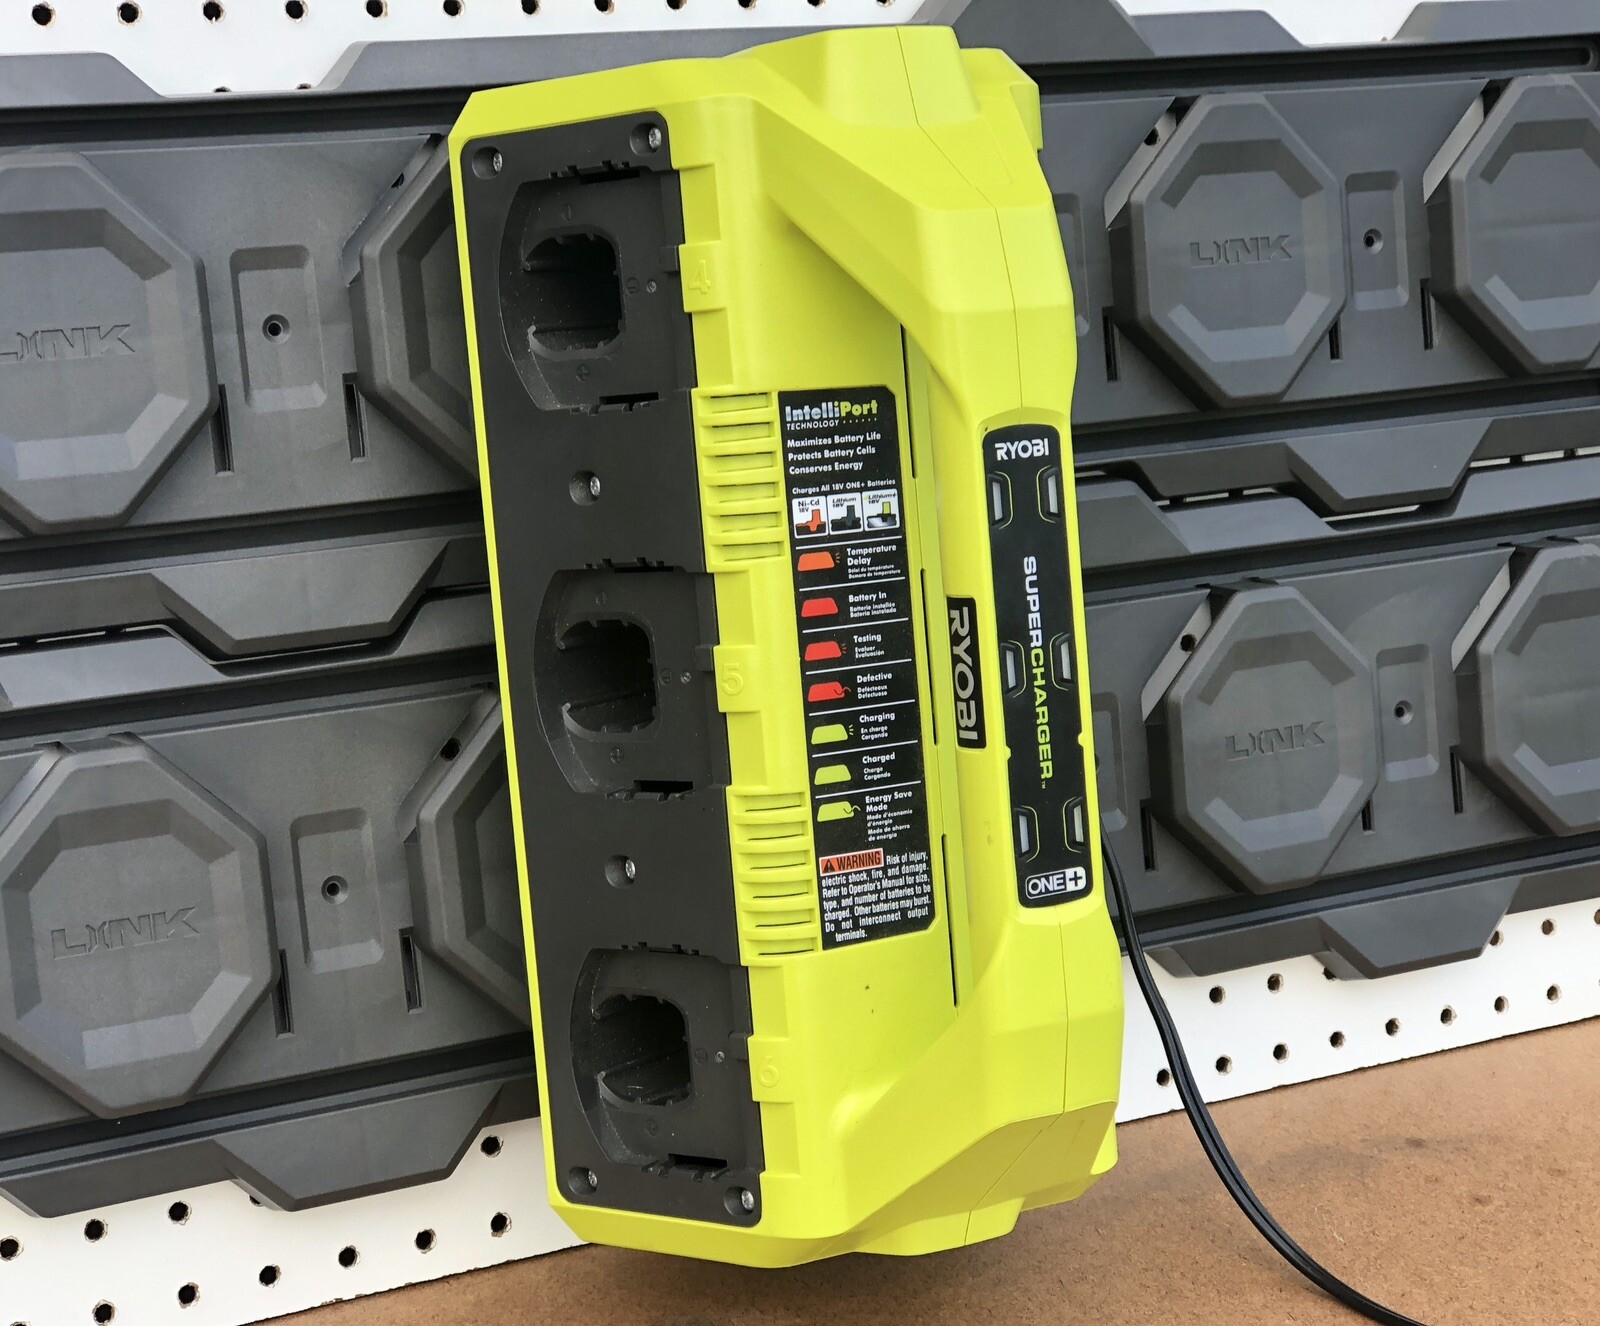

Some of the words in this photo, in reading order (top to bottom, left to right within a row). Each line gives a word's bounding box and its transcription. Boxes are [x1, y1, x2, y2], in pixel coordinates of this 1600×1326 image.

[687, 259, 711, 294] 4
[785, 400, 878, 421] IntelliPort
[786, 420, 839, 431] TECHNOLOGY
[787, 437, 832, 448] Maximizes
[834, 434, 864, 444] Battery
[866, 431, 881, 440] Life
[788, 450, 822, 461] Protects
[824, 448, 854, 458] Battery
[856, 445, 876, 455] Cells
[994, 438, 1049, 461] RYOBI
[789, 464, 832, 475] Conserves
[834, 462, 863, 471] Energy
[792, 486, 819, 494] Charges
[867, 479, 896, 487] Batteries
[798, 499, 820, 507] Ni-Cd
[846, 545, 897, 556] Temperature
[847, 557, 872, 566] Delay
[848, 593, 877, 602] Battery
[878, 591, 887, 599] In
[853, 633, 882, 643] Testing
[950, 606, 978, 740] RYOBI
[1023, 555, 1053, 780] SUPERCHARGER
[721, 663, 744, 696] 5
[857, 672, 892, 683] Defective
[859, 712, 895, 723] Charging
[861, 732, 888, 740] Cargando
[869, 725, 888, 733] charge
[862, 751, 896, 764] Charged
[863, 766, 883, 774] Charge
[864, 772, 891, 781] Cargando
[865, 793, 892, 804] Energy
[894, 791, 912, 800] Save
[866, 803, 888, 813] Mode
[836, 850, 881, 871] WARNING
[886, 854, 900, 865] Risk
[901, 853, 908, 863] of
[822, 875, 847, 888] electric
[848, 871, 870, 883] shock,
[871, 869, 886, 879] fire,
[887, 866, 900, 876] and
[901, 862, 929, 876] damage.
[822, 887, 840, 899] Refer
[841, 886, 848, 895] to
[849, 880, 881, 895] Operator's
[882, 876, 905, 889] Manual
[906, 875, 914, 885] for
[915, 872, 930, 884] size,
[823, 899, 840, 911] type,
[841, 896, 853, 906] and
[854, 892, 879, 905] number
[879, 890, 886, 900] of
[887, 886, 915, 899] batteries
[915, 885, 922, 894] to
[923, 883, 931, 893] be
[824, 908, 852, 921] charged.
[854, 905, 871, 917] Other
[872, 900, 899, 913] batteries
[900, 898, 913, 909] may
[913, 895, 931, 906] burst.
[825, 922, 835, 933] Do
[841, 919, 853, 930] not
[859, 911, 901, 926] interconnect
[907, 906, 929, 919] output
[835, 928, 868, 942] terminals.
[757, 1055, 779, 1088] 6
